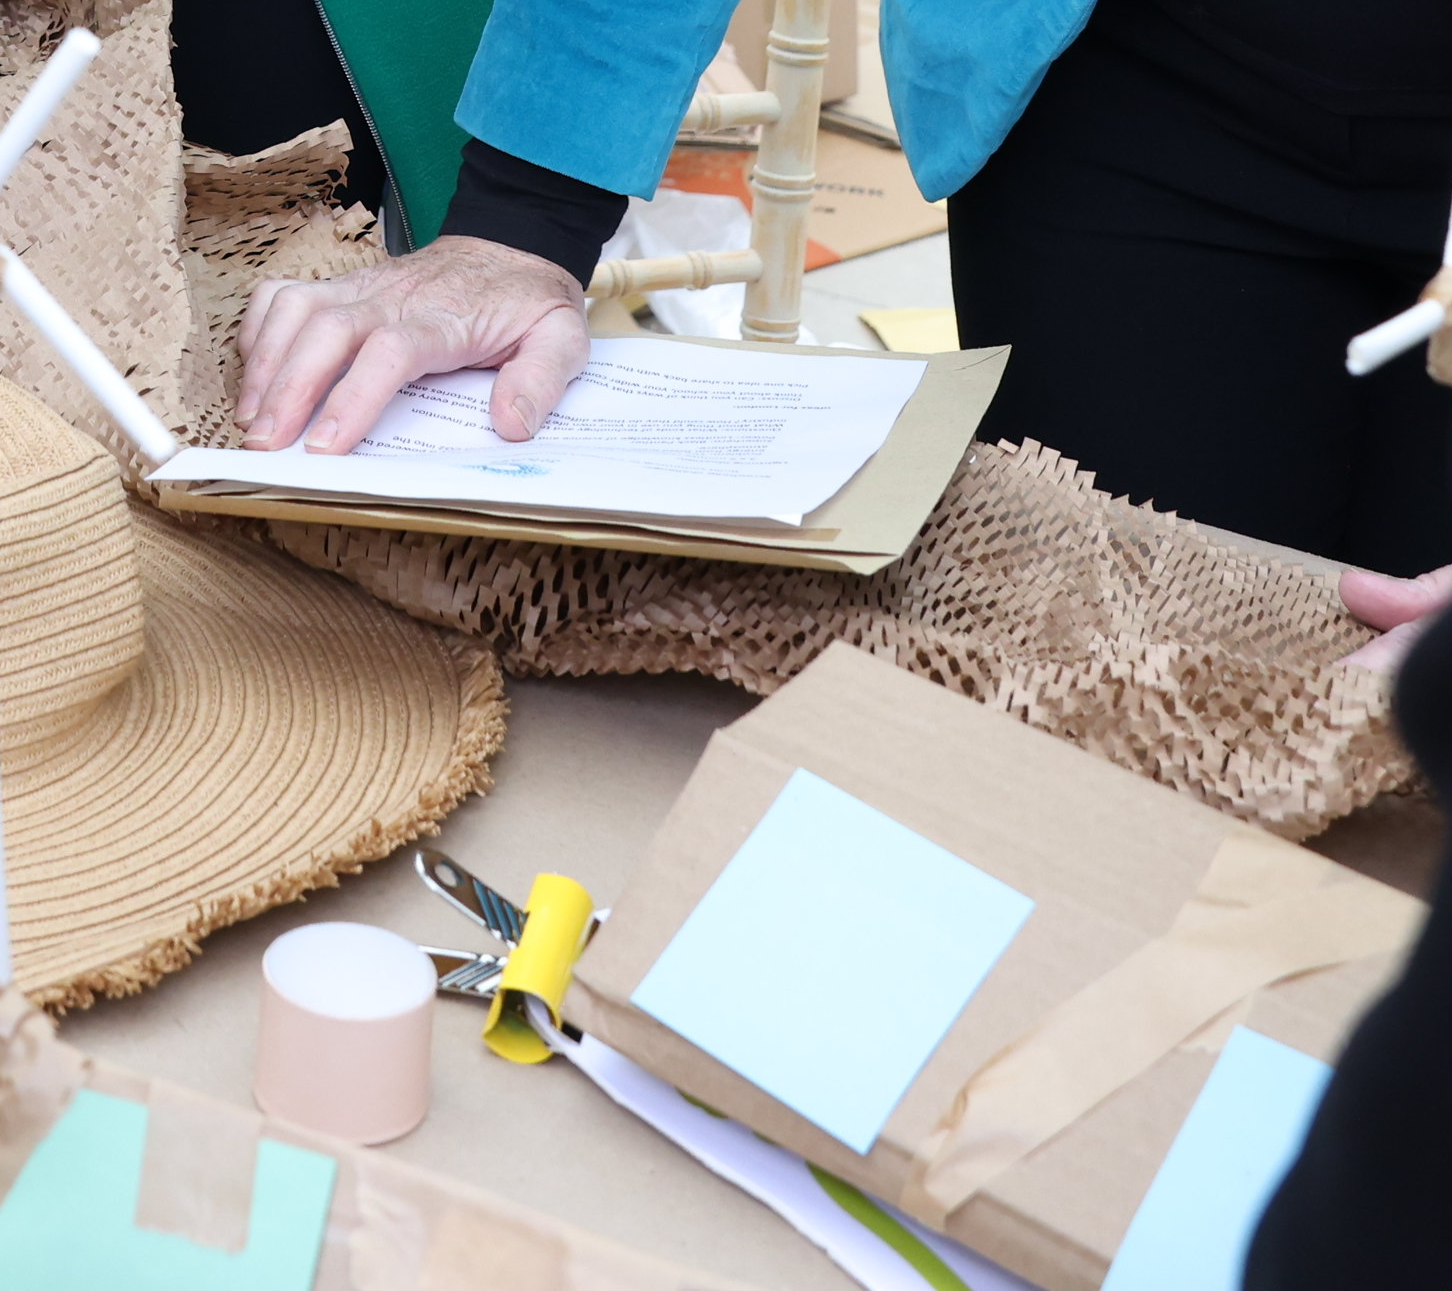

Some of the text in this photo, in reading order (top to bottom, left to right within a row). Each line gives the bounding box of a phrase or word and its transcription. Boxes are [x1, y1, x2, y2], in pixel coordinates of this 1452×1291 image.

[637, 369, 660, 377] with
[585, 378, 608, 388] your
[610, 379, 640, 387] wider
[664, 375, 687, 383] back
[396, 388, 416, 397] day
[407, 384, 428, 392] and
[612, 386, 633, 394] that
[419, 393, 448, 403] every
[431, 388, 477, 403] factories
[451, 401, 476, 410] used
[412, 408, 462, 425] invention
[393, 436, 410, 444] the
[414, 440, 435, 449] into
